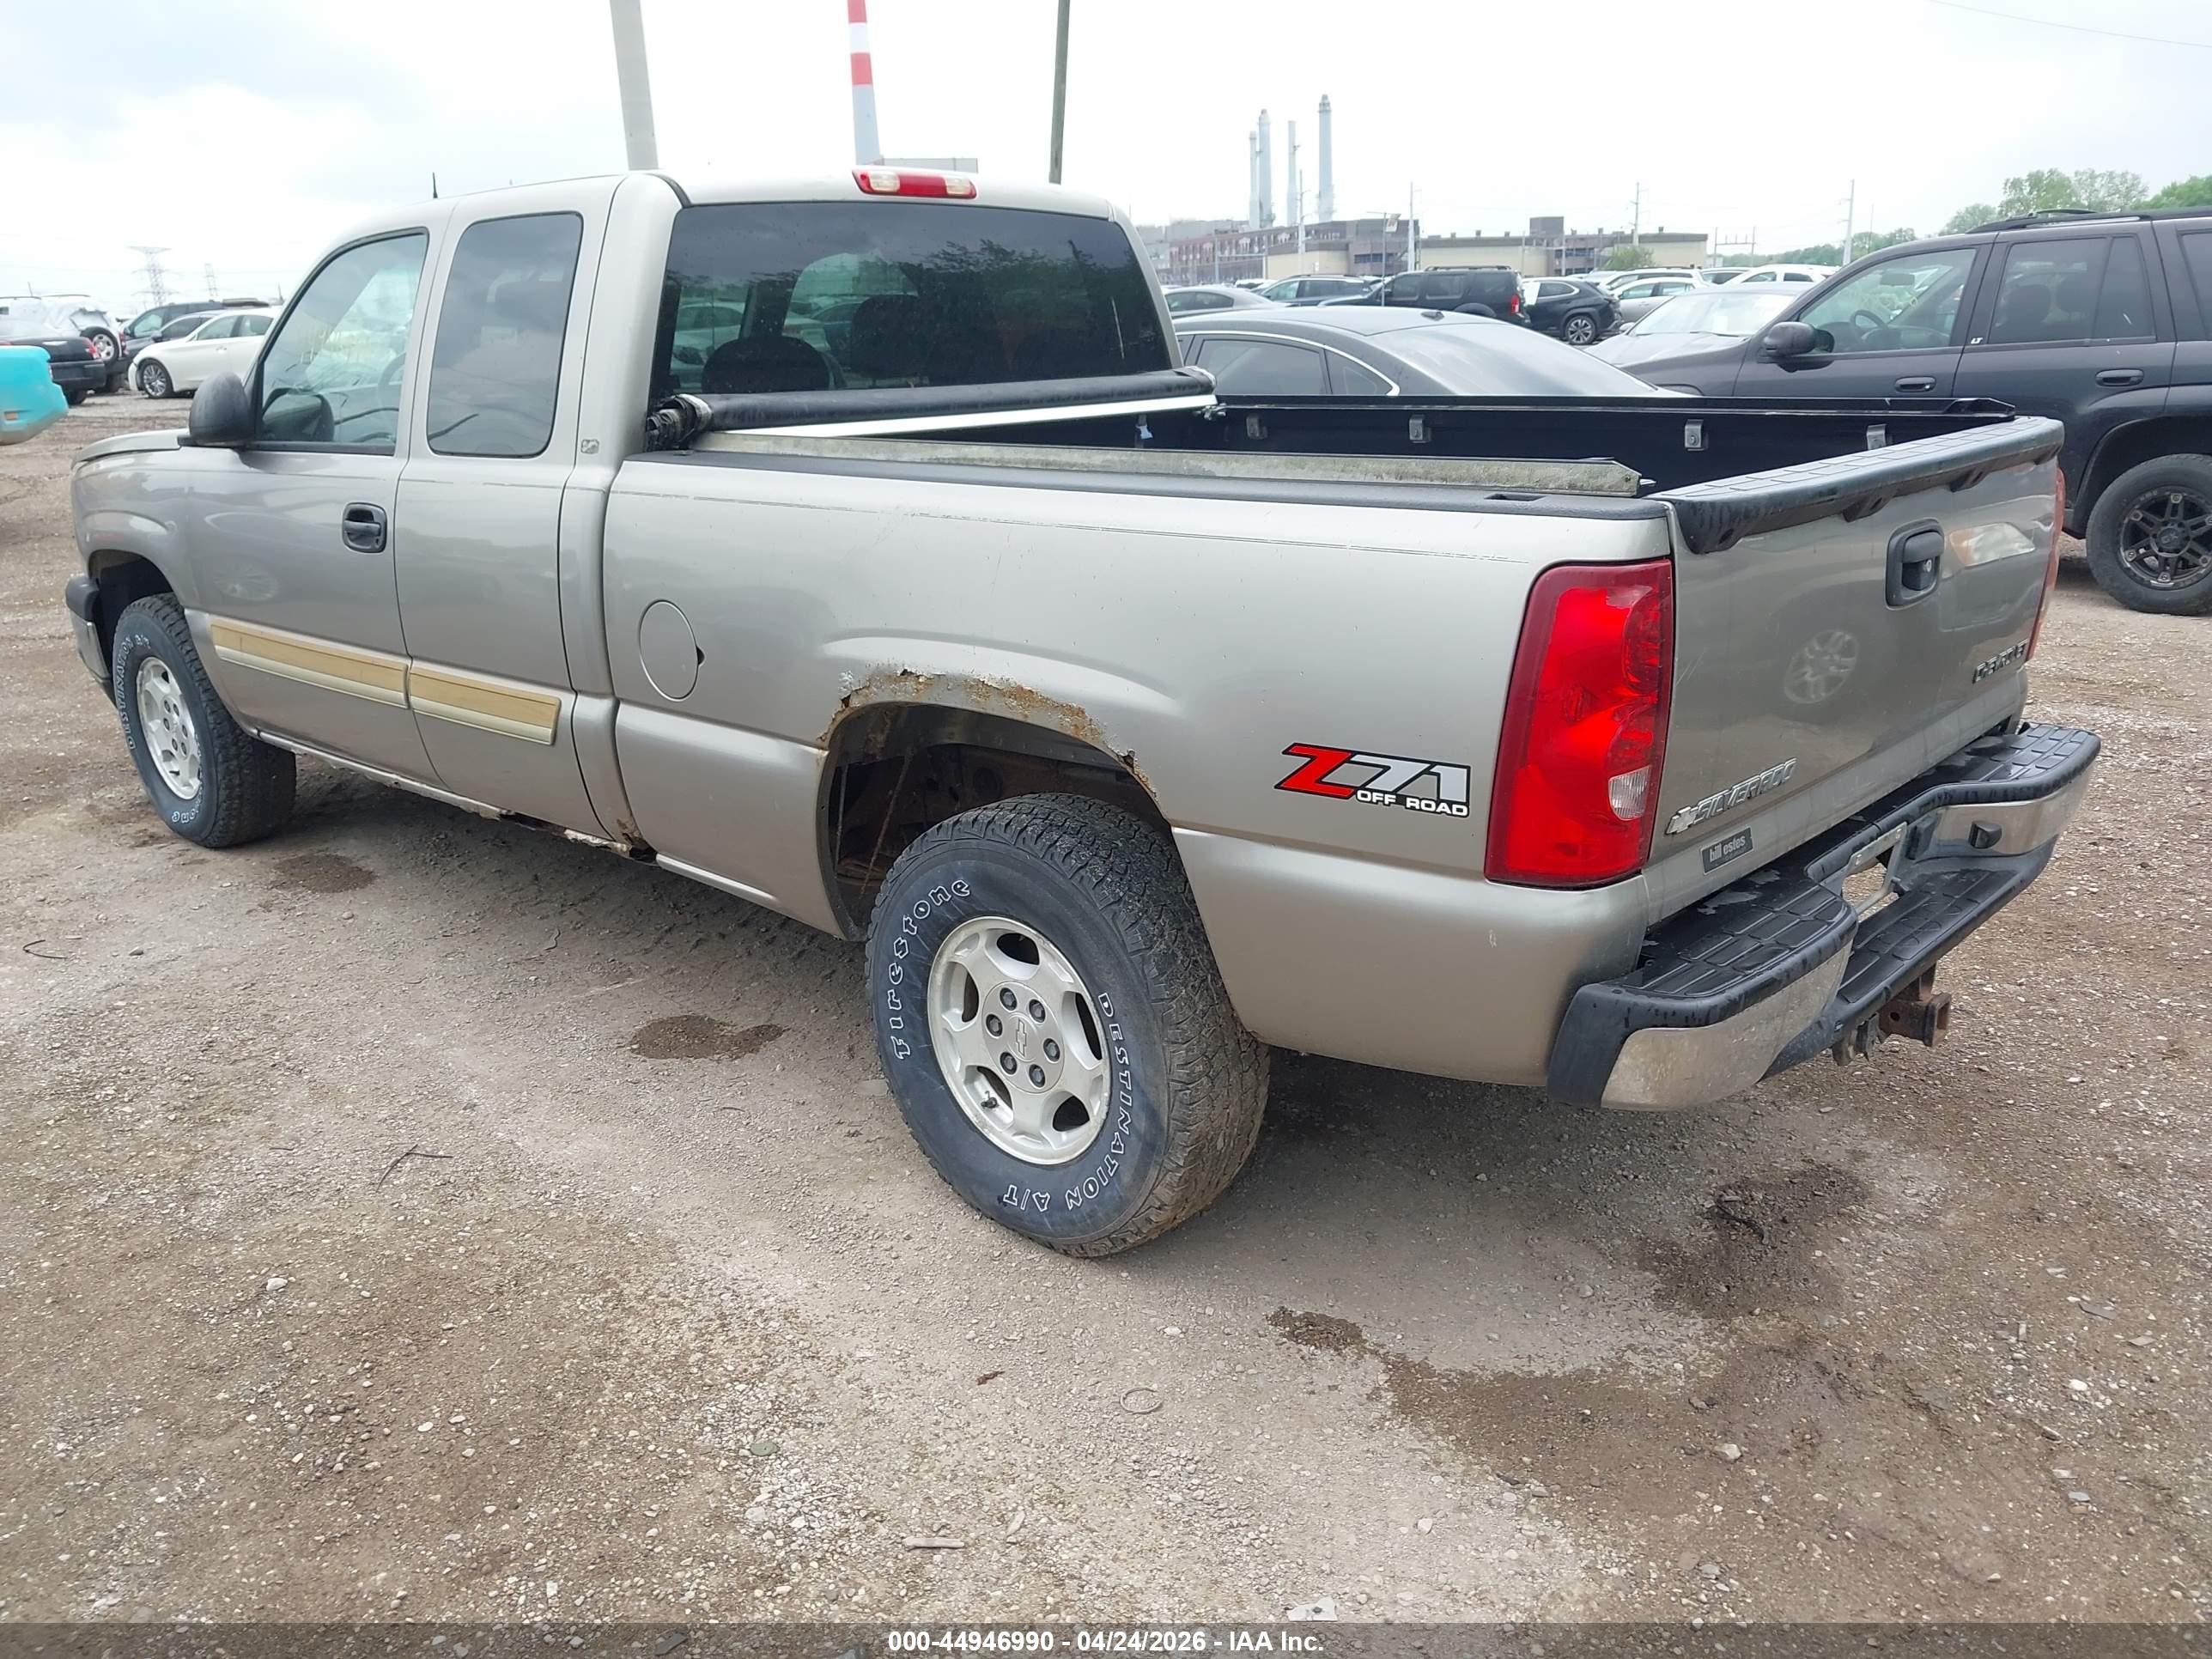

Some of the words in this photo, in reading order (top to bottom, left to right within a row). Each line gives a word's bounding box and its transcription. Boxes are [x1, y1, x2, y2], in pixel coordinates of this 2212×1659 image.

[1274, 743, 1470, 799] Z71
[1693, 757, 1798, 824] SILVERADO
[1356, 790, 1396, 805] OFF
[1406, 798, 1468, 817] ROAD
[1723, 836, 1745, 855] estes
[887, 878, 971, 1060] Firestone
[1065, 993, 1132, 1210] DESTINATION
[1003, 1184, 1051, 1212] A/T
